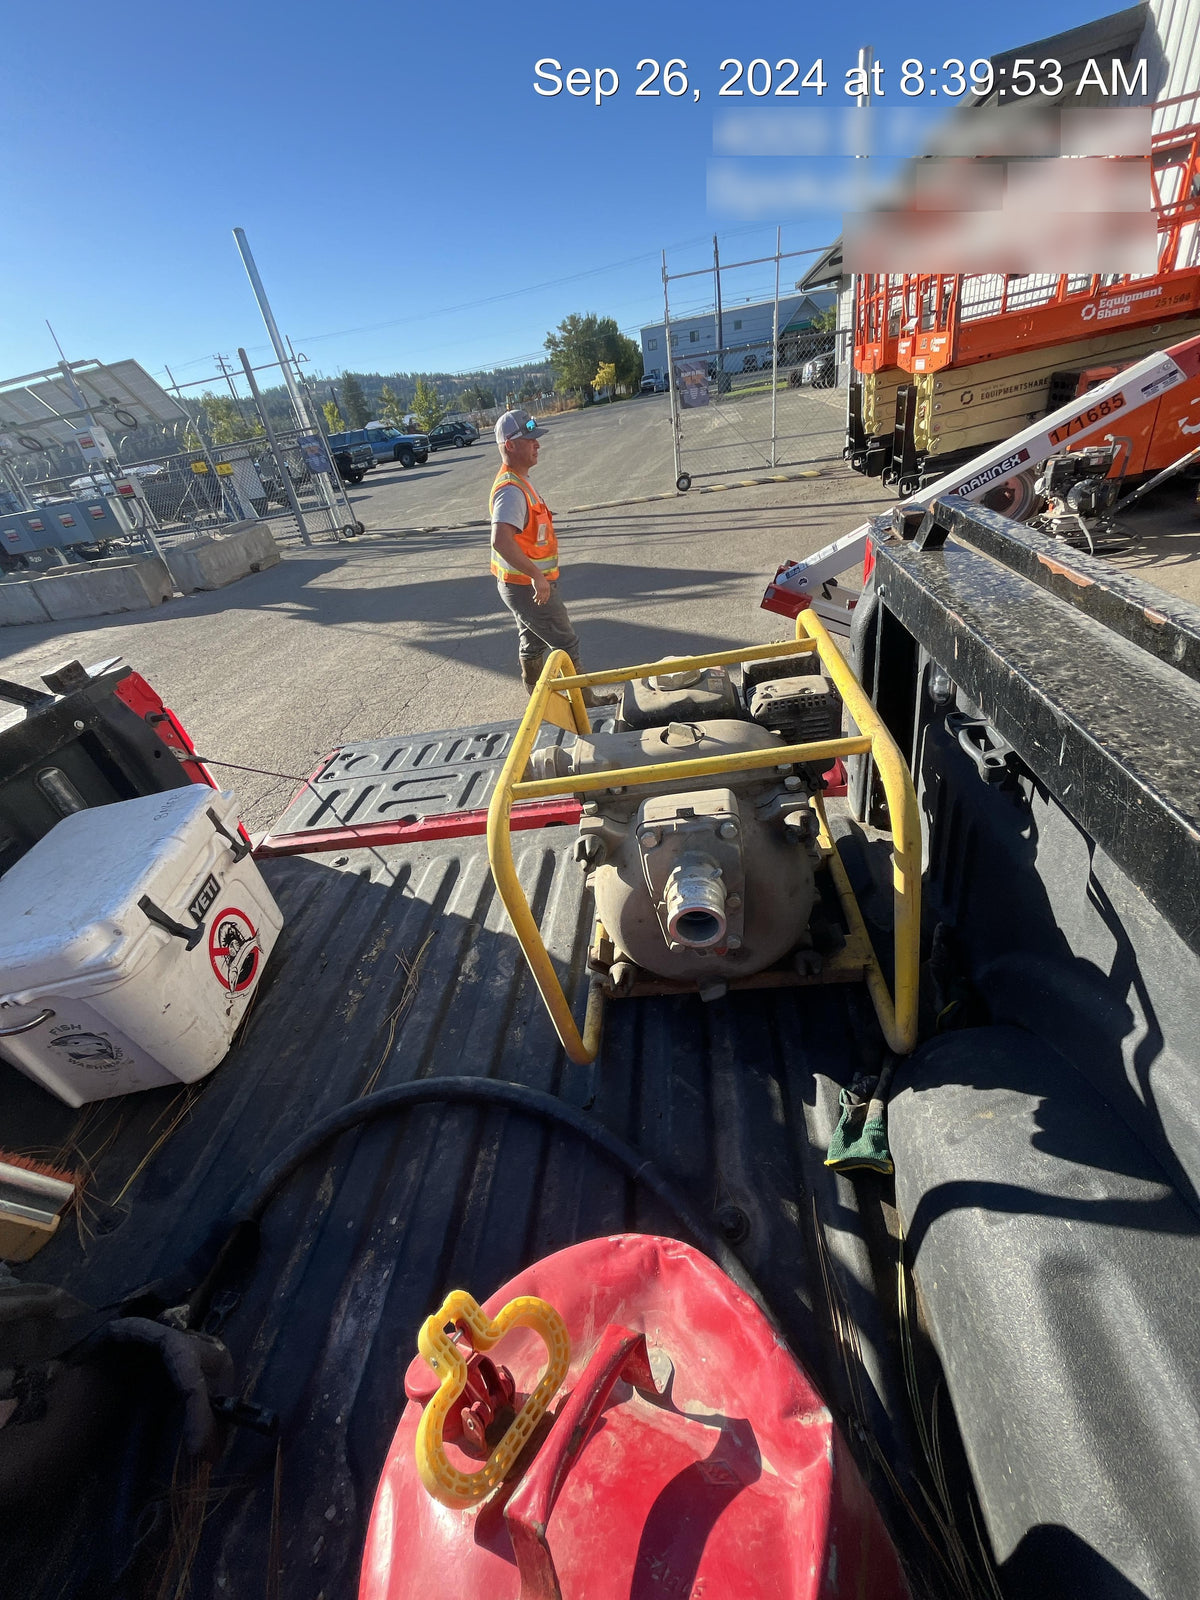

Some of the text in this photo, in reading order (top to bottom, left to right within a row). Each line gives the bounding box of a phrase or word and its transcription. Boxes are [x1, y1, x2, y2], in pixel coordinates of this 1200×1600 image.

[1099, 286, 1163, 309] Equipment
[1097, 305, 1131, 319] Share
[980, 377, 1049, 401] EQUIPMENTSHARE
[1051, 393, 1125, 443] 171685
[957, 453, 1022, 496] MAKINEX
[190, 878, 218, 918] YETI
[49, 1023, 82, 1036] FISH
